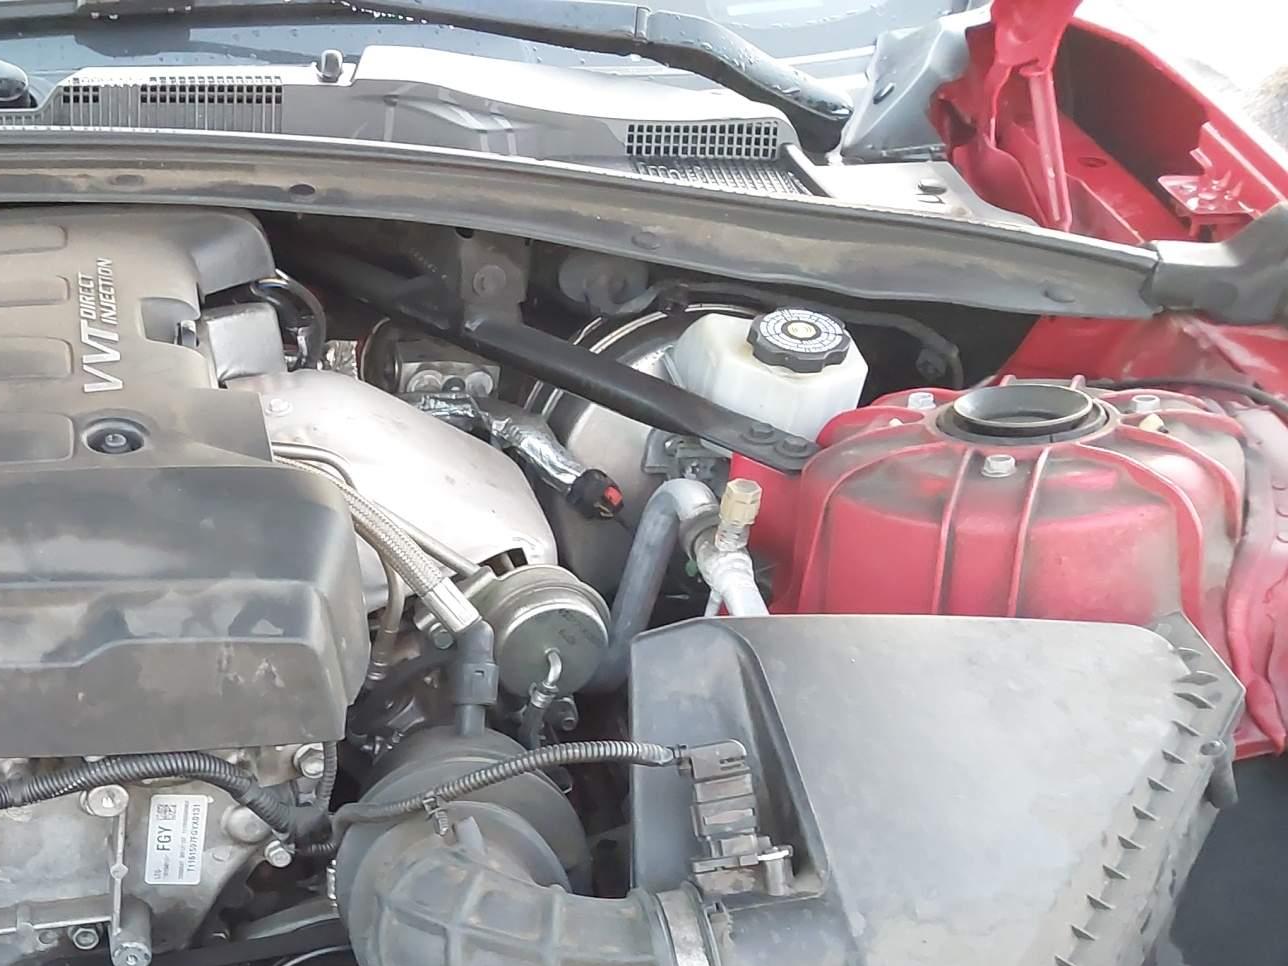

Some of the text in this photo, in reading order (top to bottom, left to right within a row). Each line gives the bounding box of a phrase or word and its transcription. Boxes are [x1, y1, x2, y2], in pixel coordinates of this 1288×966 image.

[78, 271, 97, 320] DIRECT
[96, 257, 118, 325] INJECTION
[80, 319, 123, 393] VVT
[156, 825, 173, 852] FGY
